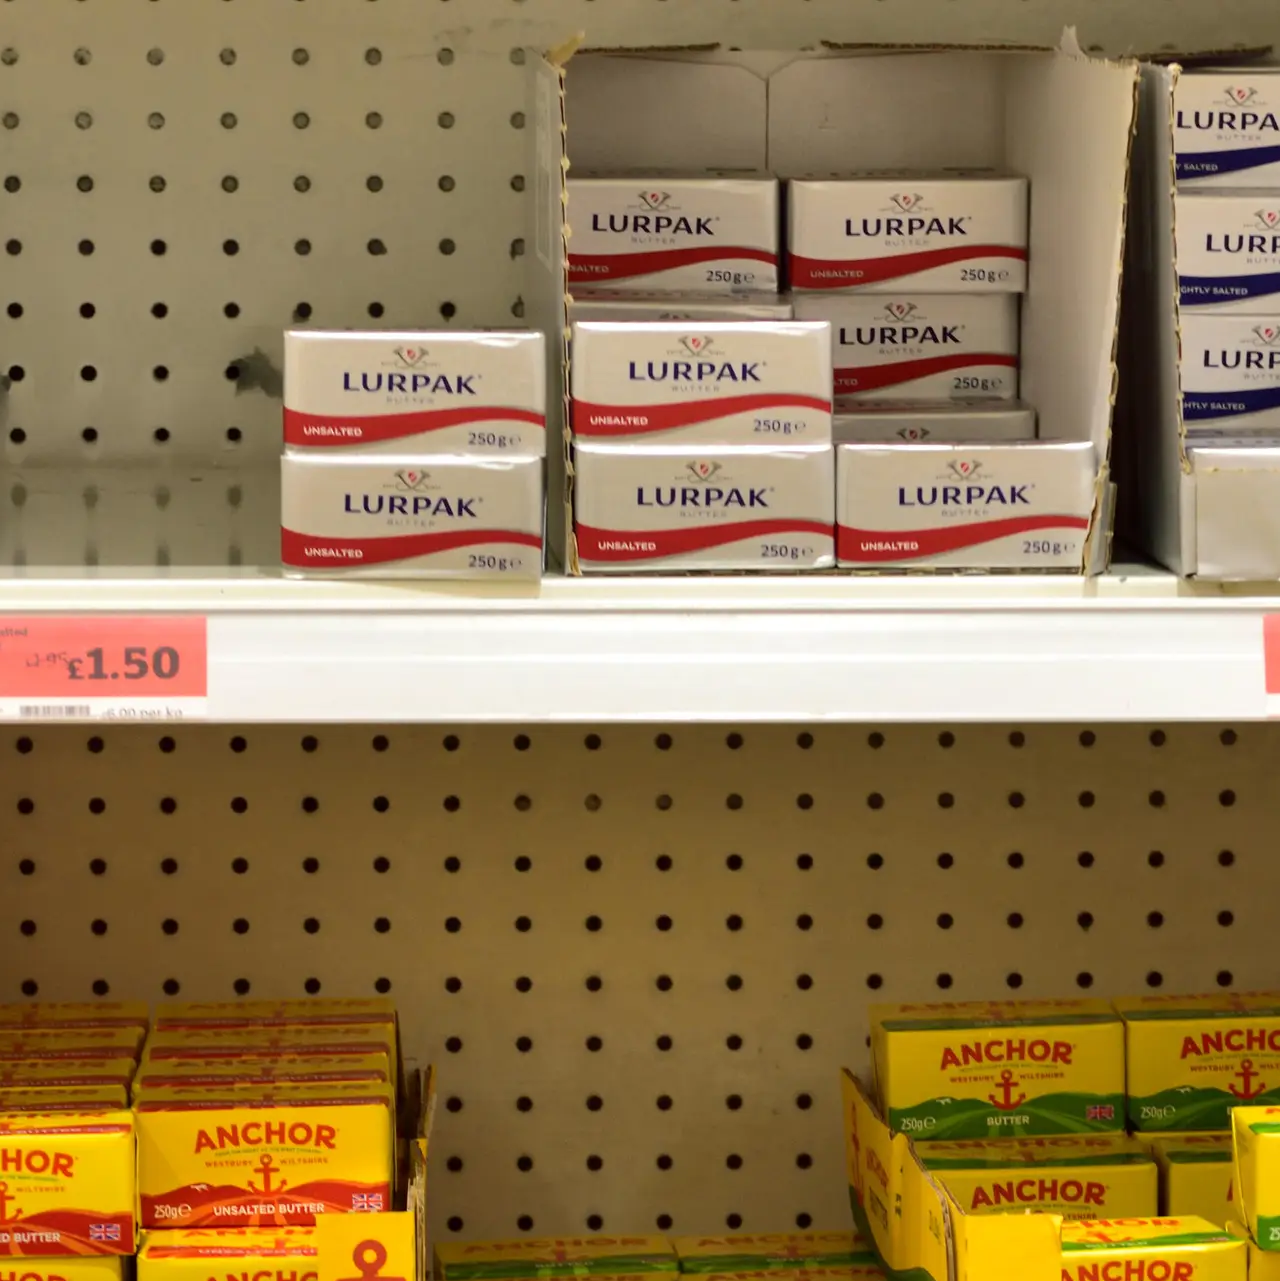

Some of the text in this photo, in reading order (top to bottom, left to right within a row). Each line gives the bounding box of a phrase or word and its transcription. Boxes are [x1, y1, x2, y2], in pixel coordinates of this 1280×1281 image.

[592, 212, 715, 236] LURPAK
[845, 217, 967, 238] LURPAK
[343, 371, 476, 395] LURPAK
[628, 360, 761, 383] LURPAK
[304, 426, 363, 438] UNSALTED
[343, 493, 477, 517] LURPAK
[898, 485, 1030, 507] LURPAK
[68, 646, 180, 680] £1.50
[17, 1231, 60, 1242] BUTTER
